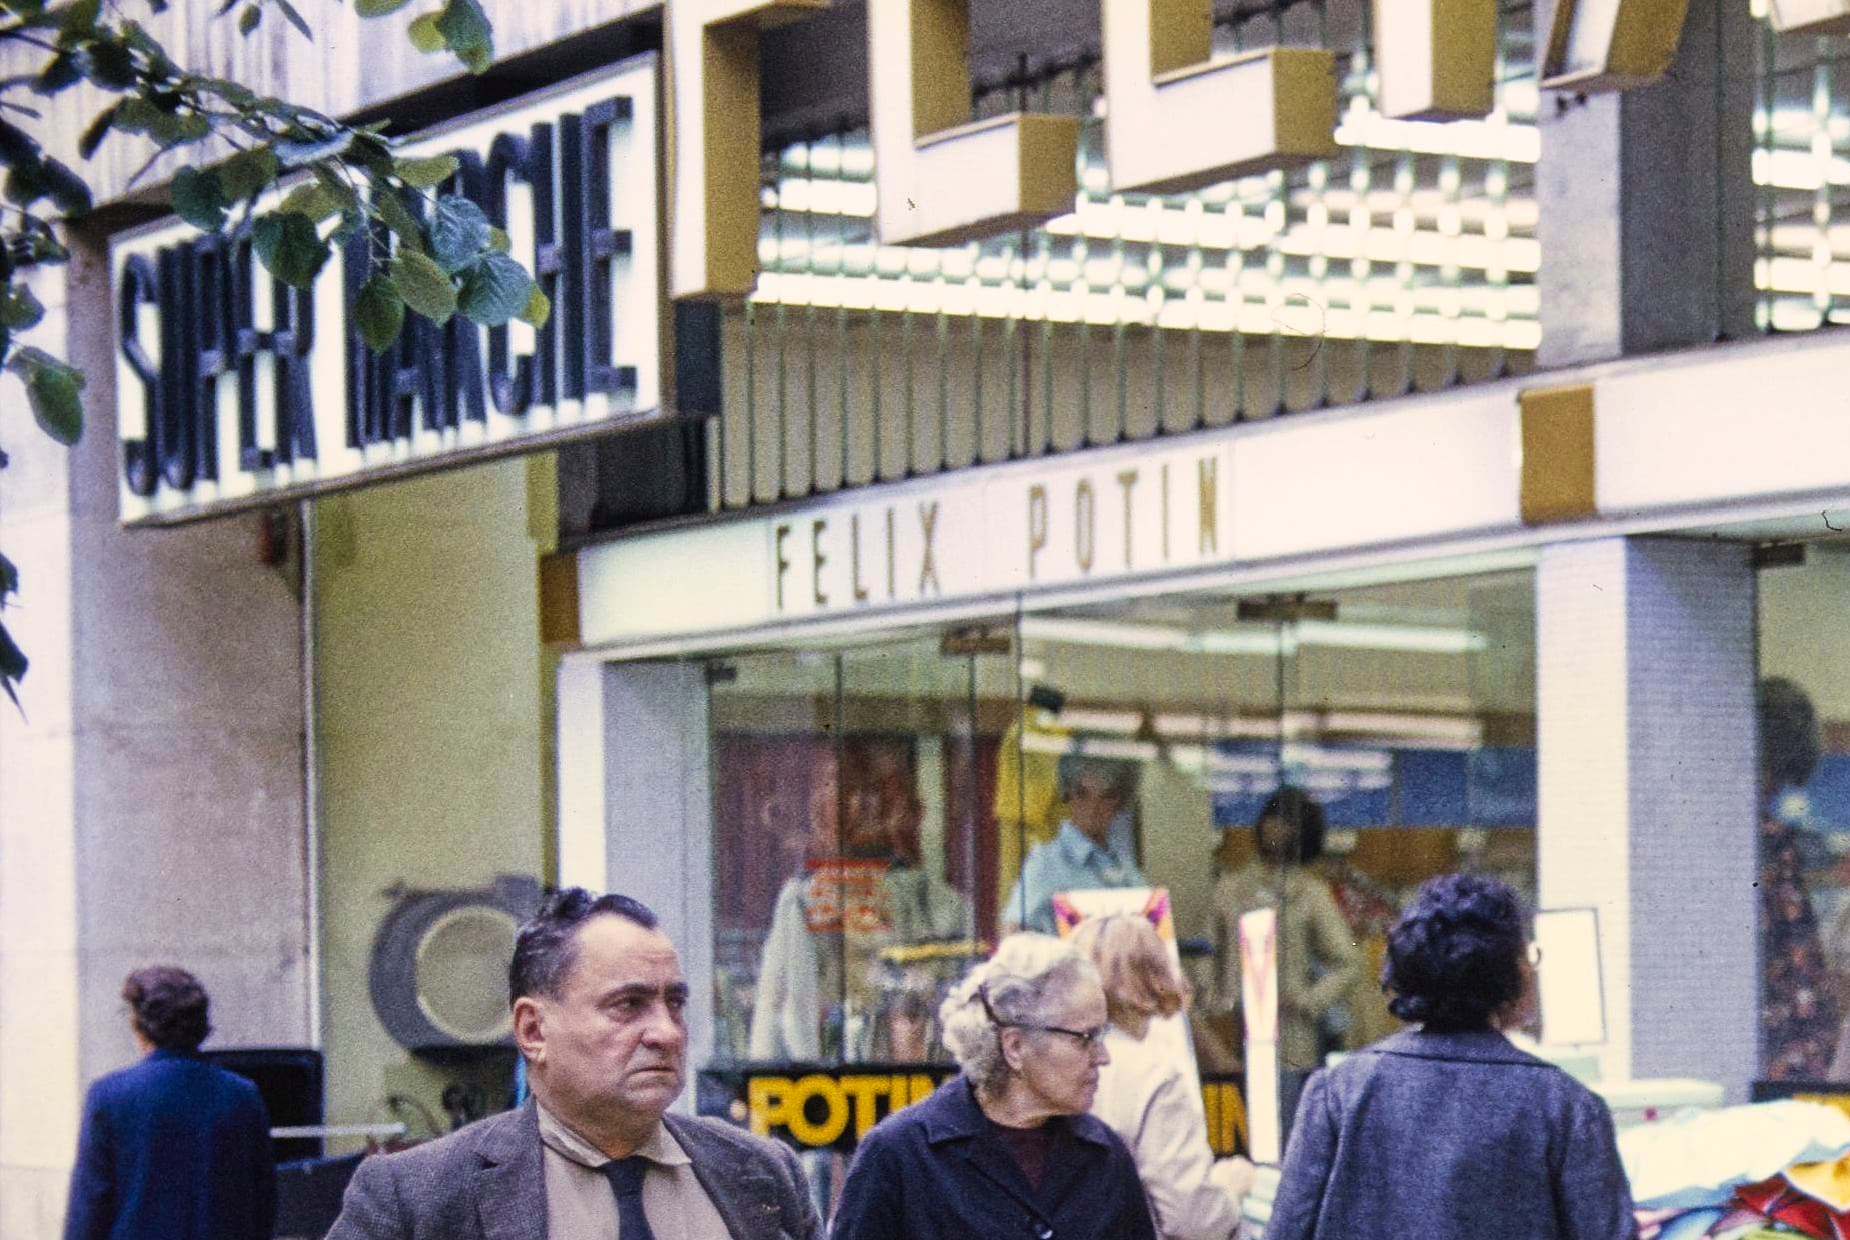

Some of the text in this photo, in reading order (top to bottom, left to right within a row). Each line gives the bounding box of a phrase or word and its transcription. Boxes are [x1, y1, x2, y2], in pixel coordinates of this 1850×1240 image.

[776, 456, 1218, 611] FELIX POTIN
[748, 1074, 958, 1146] POTI
